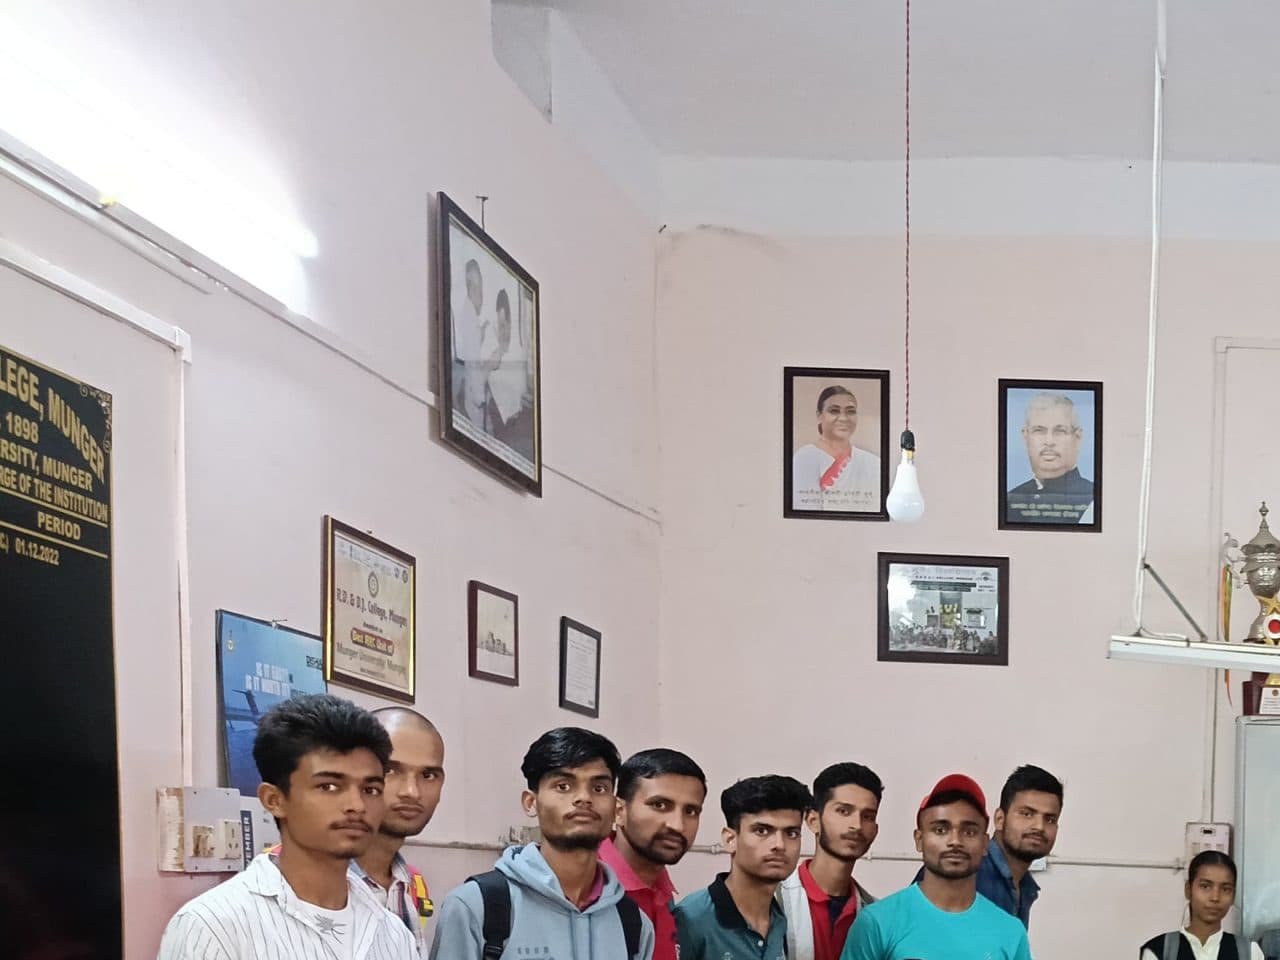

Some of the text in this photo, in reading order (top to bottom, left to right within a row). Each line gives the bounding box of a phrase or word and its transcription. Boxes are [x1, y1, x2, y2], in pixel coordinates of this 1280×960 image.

[5, 411, 39, 444] 1898
[48, 386, 105, 485] MUNGER
[42, 455, 93, 492] MUNGER
[19, 473, 33, 494] OF
[33, 478, 52, 503] THE
[54, 485, 109, 523] INSTITUTION
[37, 511, 81, 540] PERIOD
[15, 537, 60, 566] 01.12.2022
